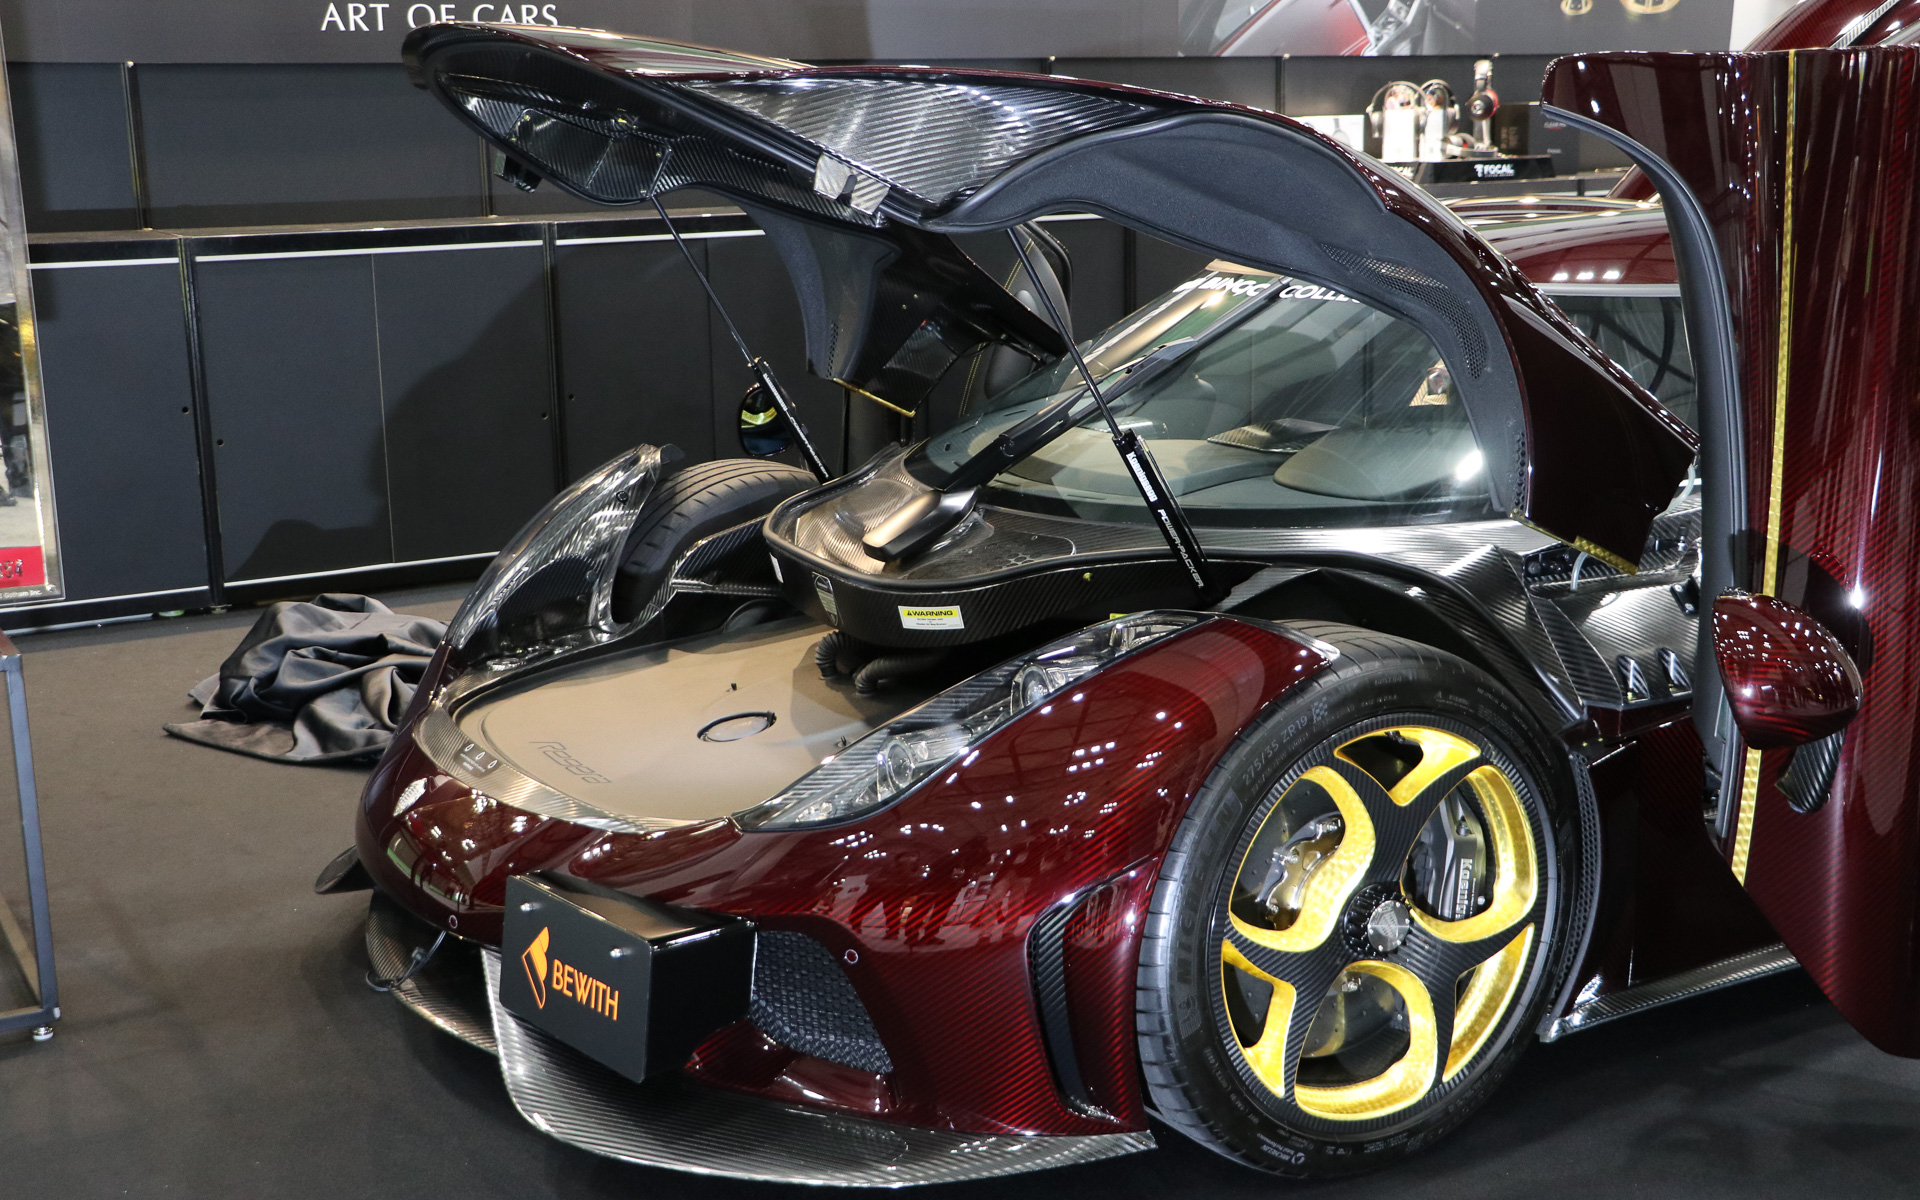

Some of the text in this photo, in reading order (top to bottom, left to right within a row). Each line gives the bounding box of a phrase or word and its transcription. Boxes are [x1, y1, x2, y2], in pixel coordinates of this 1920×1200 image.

[320, 2, 390, 32] ART
[472, 4, 559, 26] CARS
[1484, 163, 1515, 174] FOCAL
[1125, 451, 1159, 503] Koenigsegg
[1158, 508, 1204, 589] POWER-PACKER
[1242, 739, 1279, 786] 275/35
[1280, 715, 1309, 744] ZR19
[551, 958, 619, 1021] BEWITH
